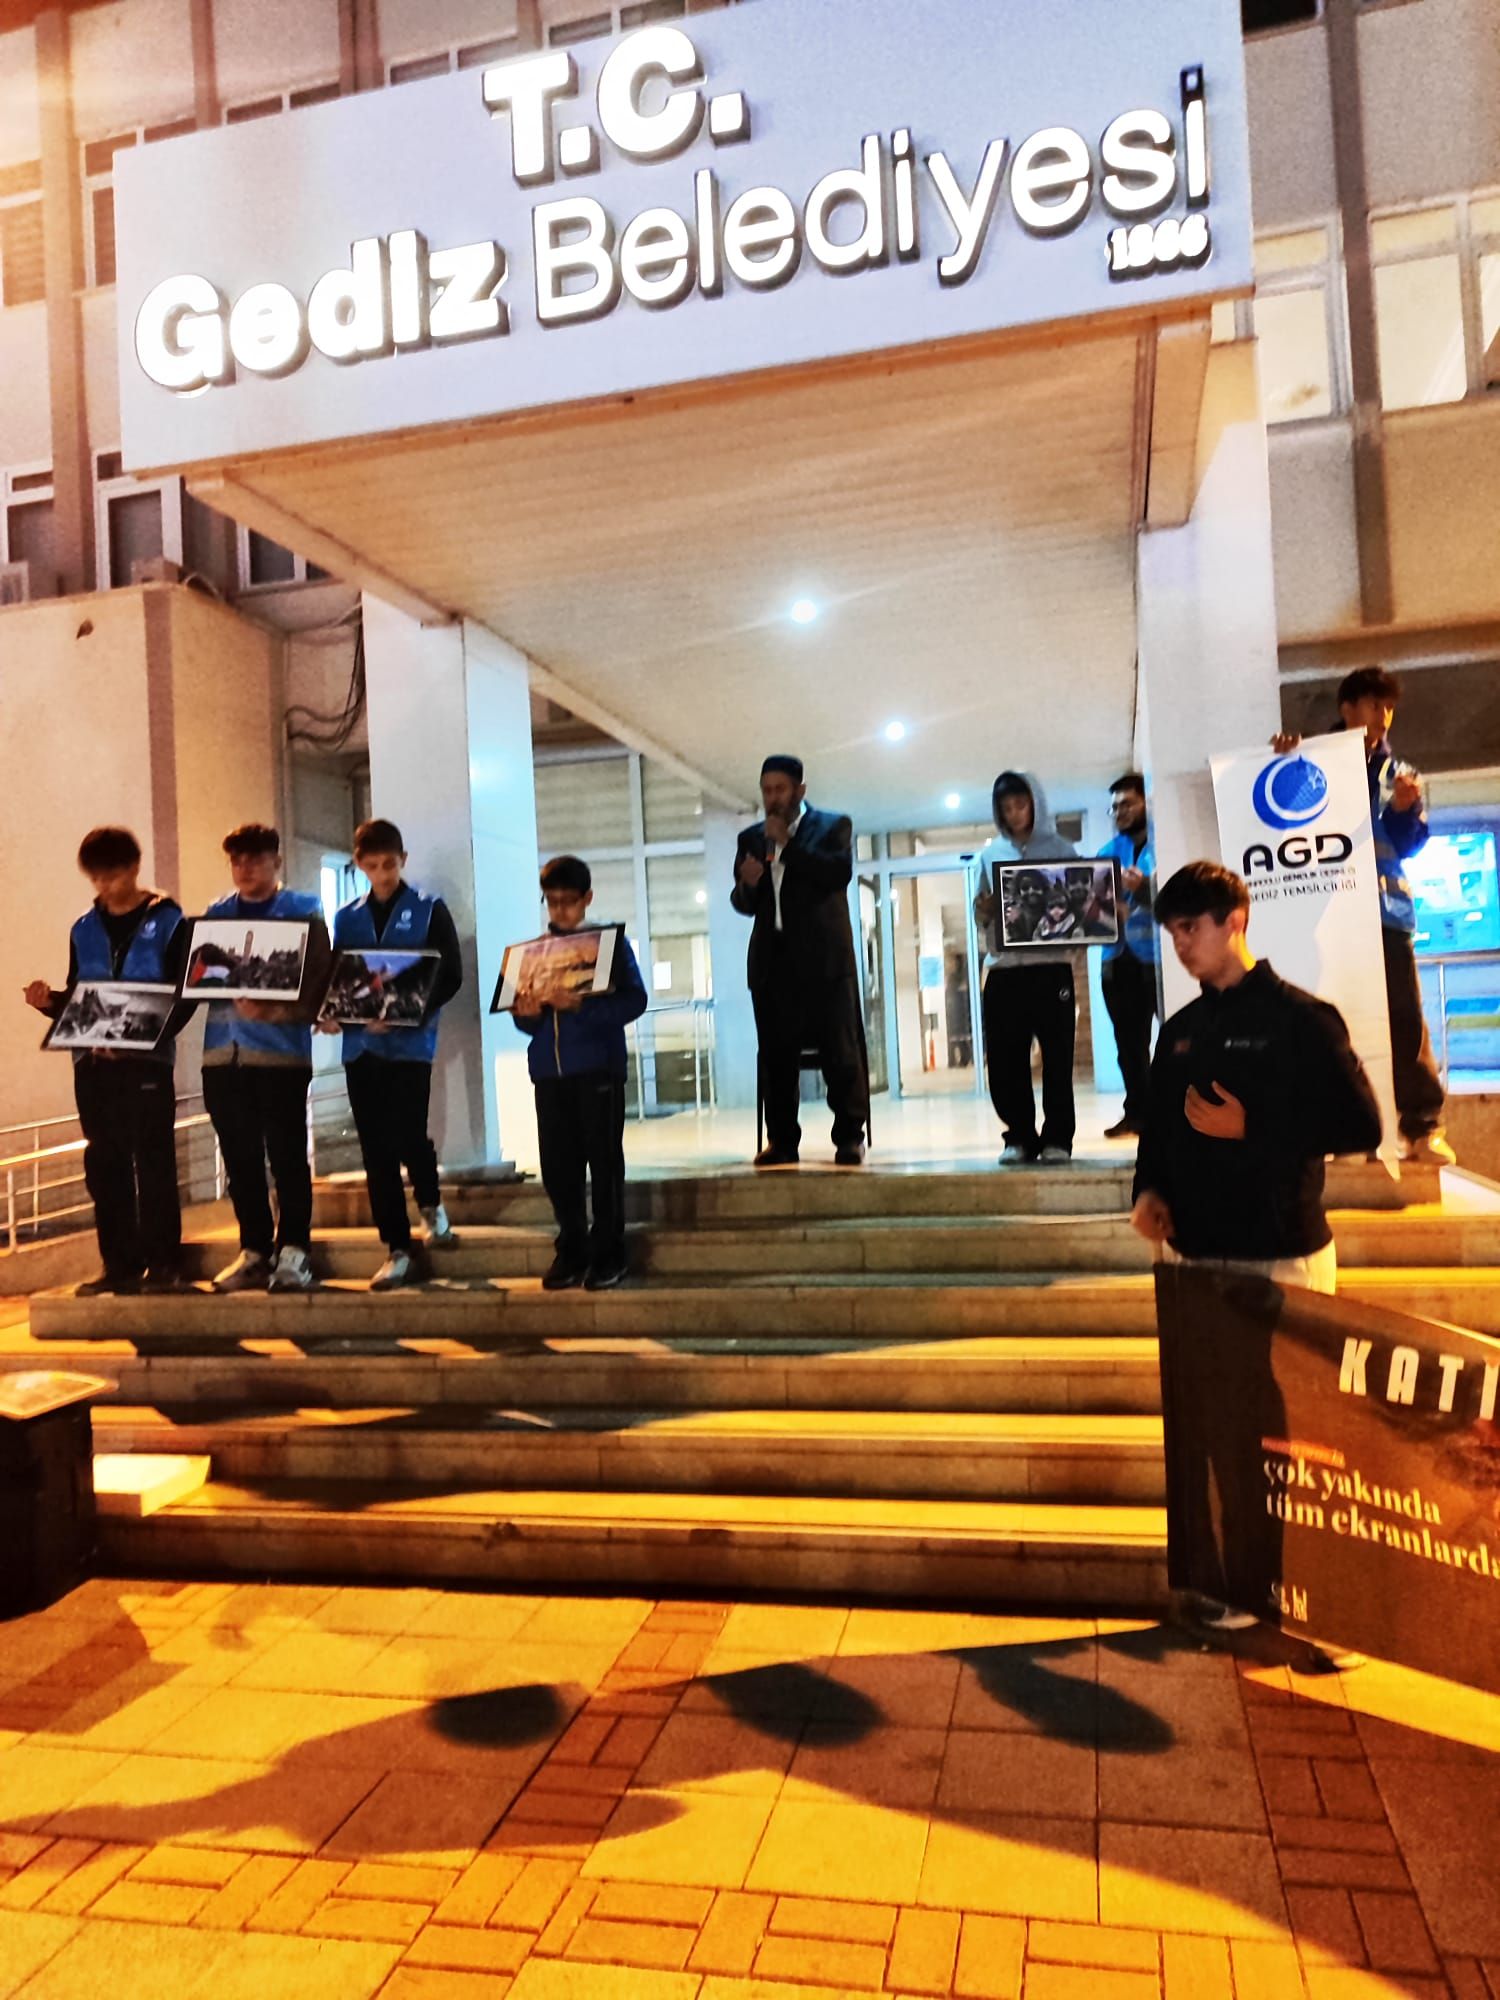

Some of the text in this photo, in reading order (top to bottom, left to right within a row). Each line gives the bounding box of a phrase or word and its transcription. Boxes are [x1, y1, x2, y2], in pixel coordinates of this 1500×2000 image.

[482, 25, 751, 188] T.C.
[532, 63, 1212, 328] Belediyesi
[1242, 833, 1353, 876] AGD
[1321, 1468, 1442, 1526] yakında
